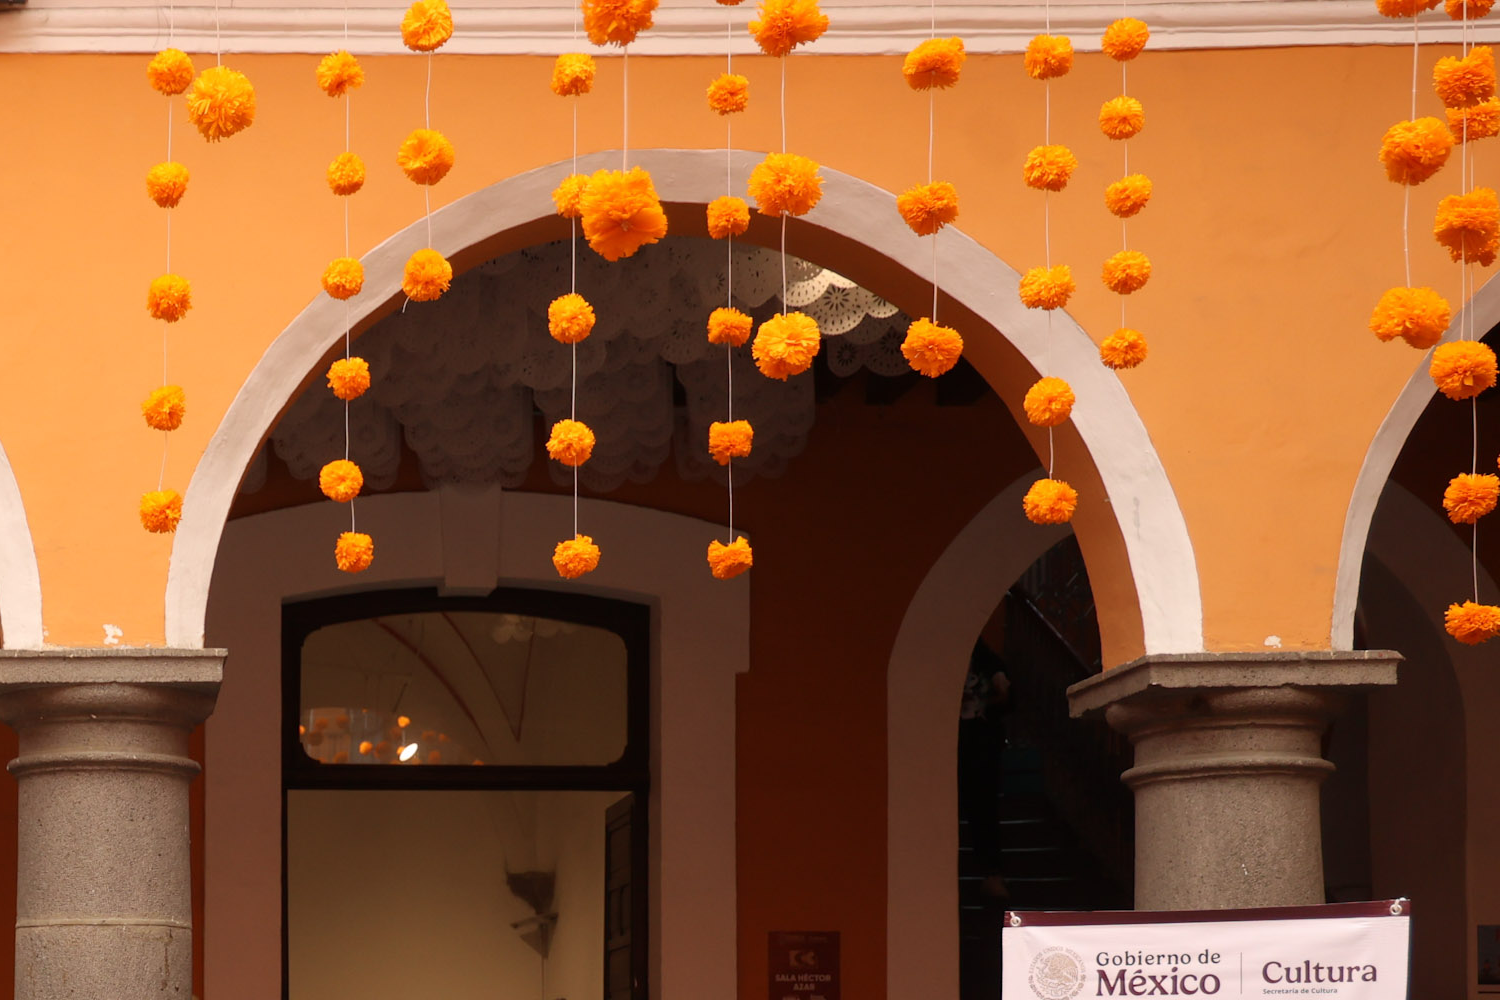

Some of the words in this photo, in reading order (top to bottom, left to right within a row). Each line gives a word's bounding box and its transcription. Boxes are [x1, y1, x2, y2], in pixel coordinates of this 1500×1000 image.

[1096, 951, 1192, 966] Gobierno
[1198, 949, 1221, 964] de
[1095, 967, 1221, 996] México
[1262, 960, 1377, 984] Cultura
